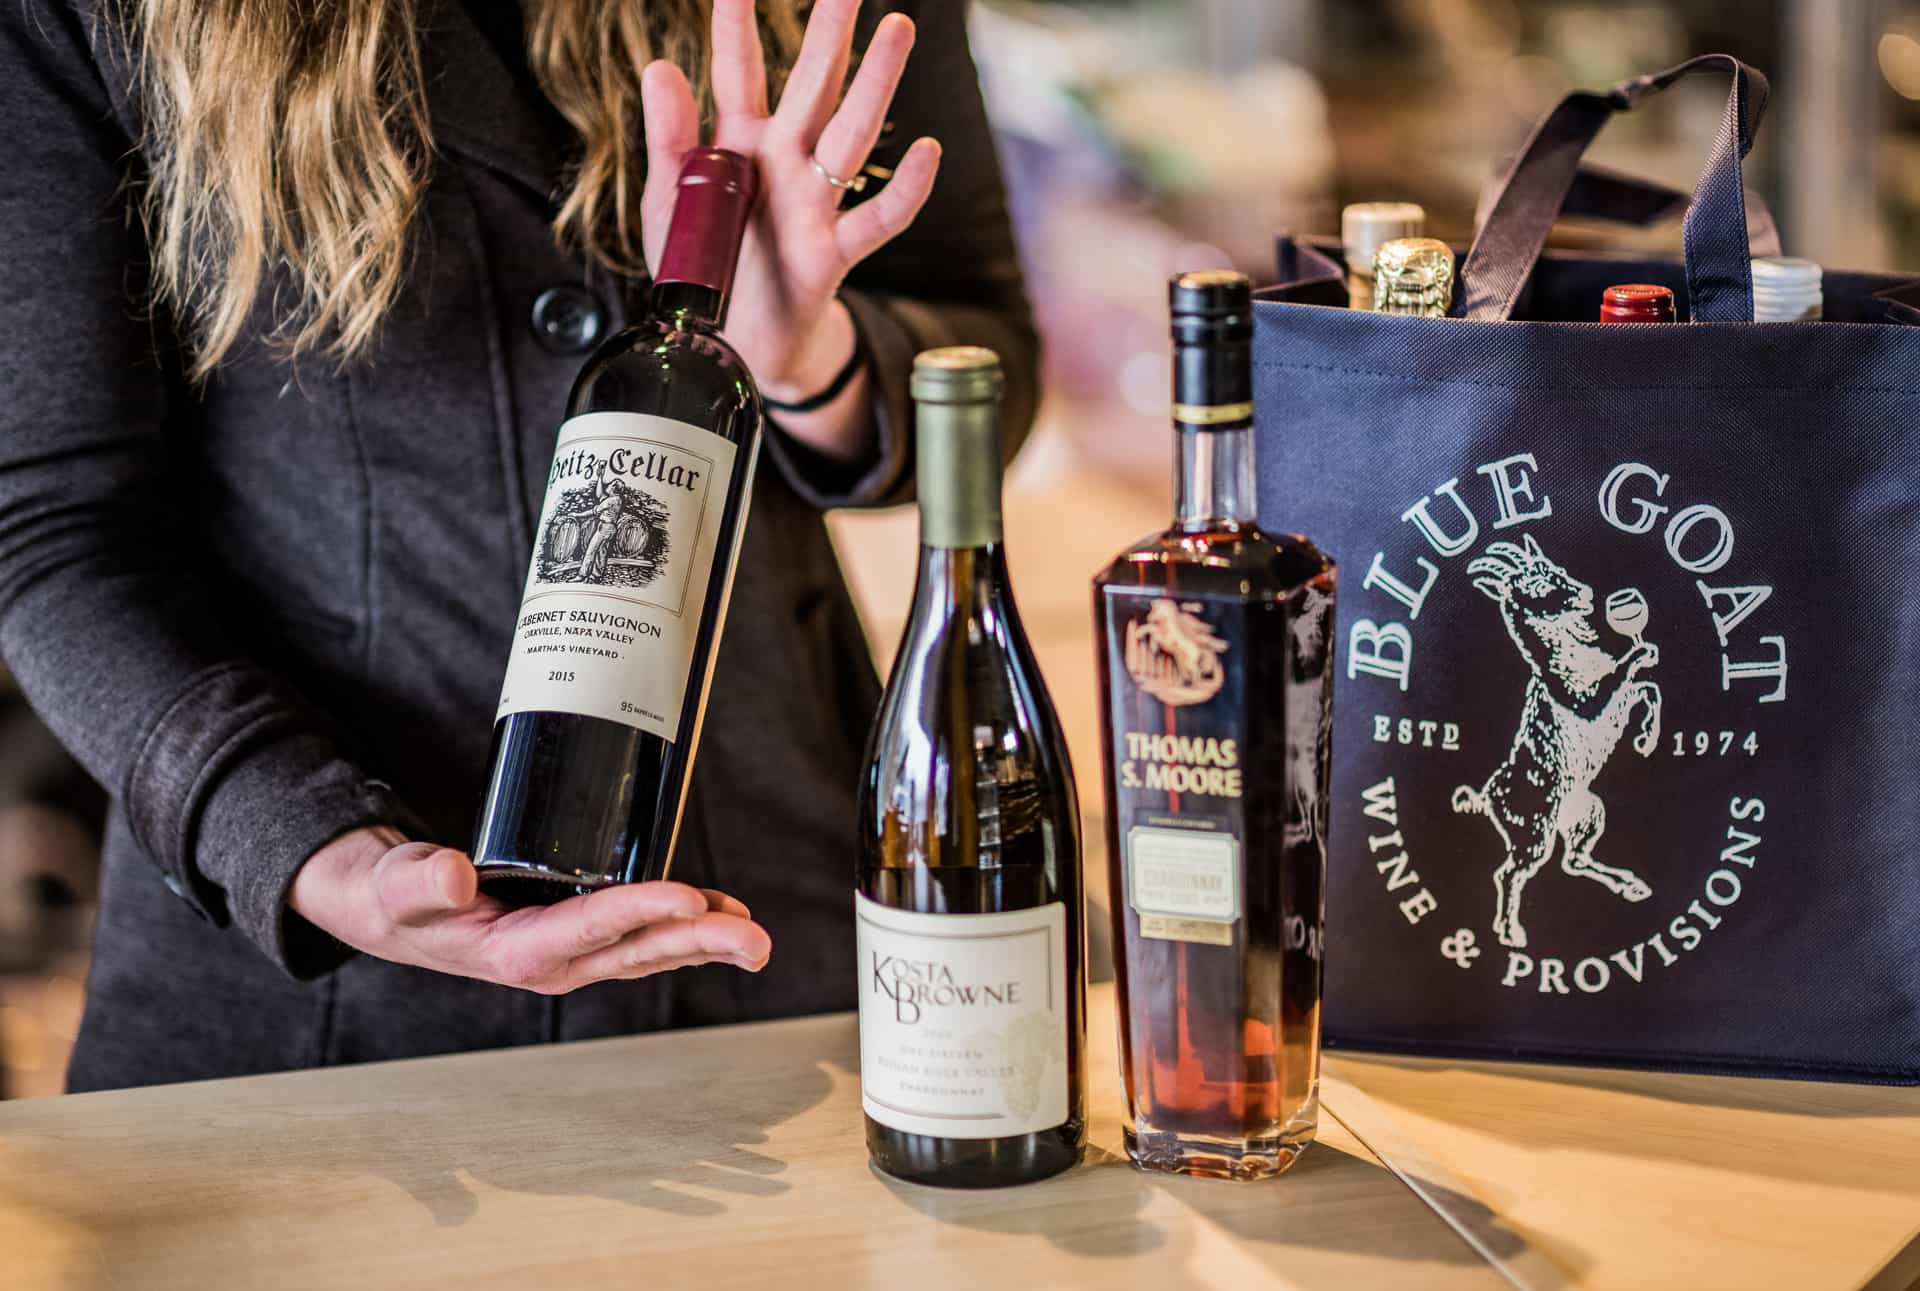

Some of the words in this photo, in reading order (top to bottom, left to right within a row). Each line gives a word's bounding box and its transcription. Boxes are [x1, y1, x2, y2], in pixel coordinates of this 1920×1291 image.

[608, 448, 700, 491] Cellar
[1347, 452, 1553, 692] BLUE
[1598, 462, 1788, 704] GOAT
[564, 626, 593, 637] NAPA
[595, 629, 635, 645] VALLEY
[568, 610, 662, 638] SAUVIGNON
[568, 645, 619, 659] VINEYARD
[547, 670, 576, 682] 2015
[620, 701, 633, 713] 95
[1125, 731, 1239, 768] THOMAS
[1672, 732, 1760, 756] 1974
[1121, 759, 1142, 788] S.
[1145, 762, 1243, 798] MOORE
[1361, 776, 1437, 925] WINE
[1440, 928, 1481, 968] &
[1501, 796, 1765, 995] PROVISIONS
[871, 950, 954, 1000] KOSTA
[895, 980, 1022, 1025] BROWNE
